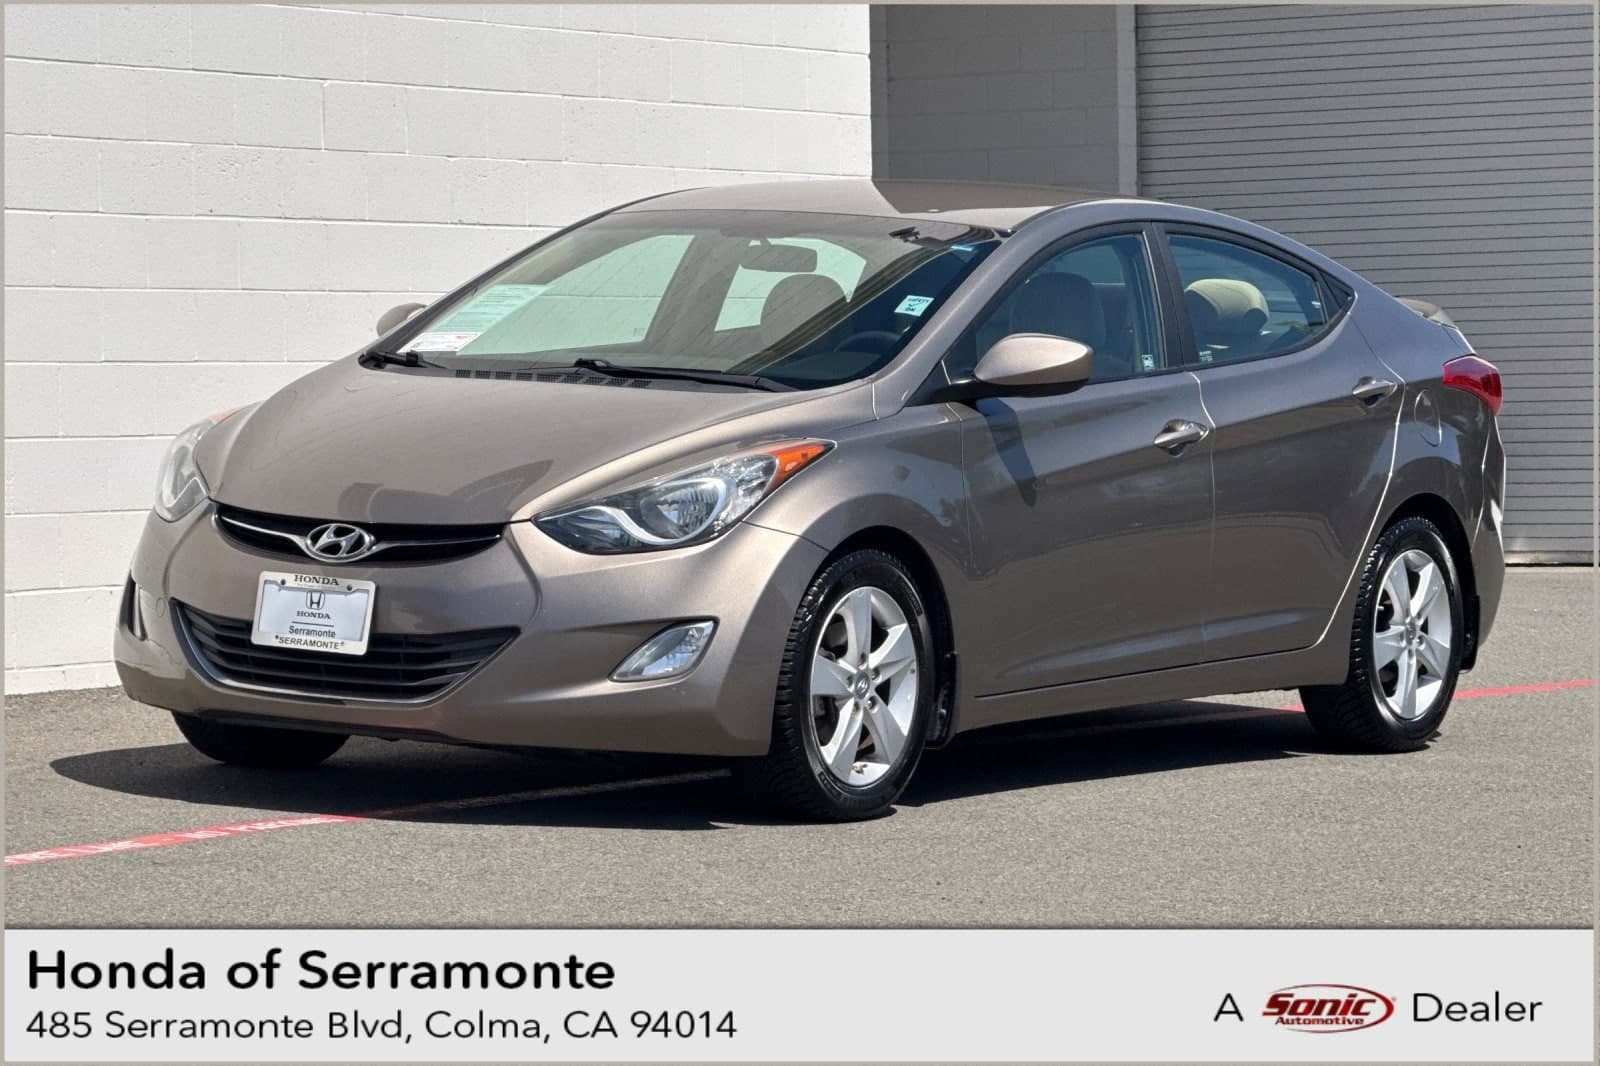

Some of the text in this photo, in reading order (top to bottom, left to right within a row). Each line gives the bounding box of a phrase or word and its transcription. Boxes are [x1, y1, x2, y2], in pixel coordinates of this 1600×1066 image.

[294, 574, 339, 586] HONDA
[296, 610, 331, 619] HONDA
[289, 625, 336, 638] Serramonte
